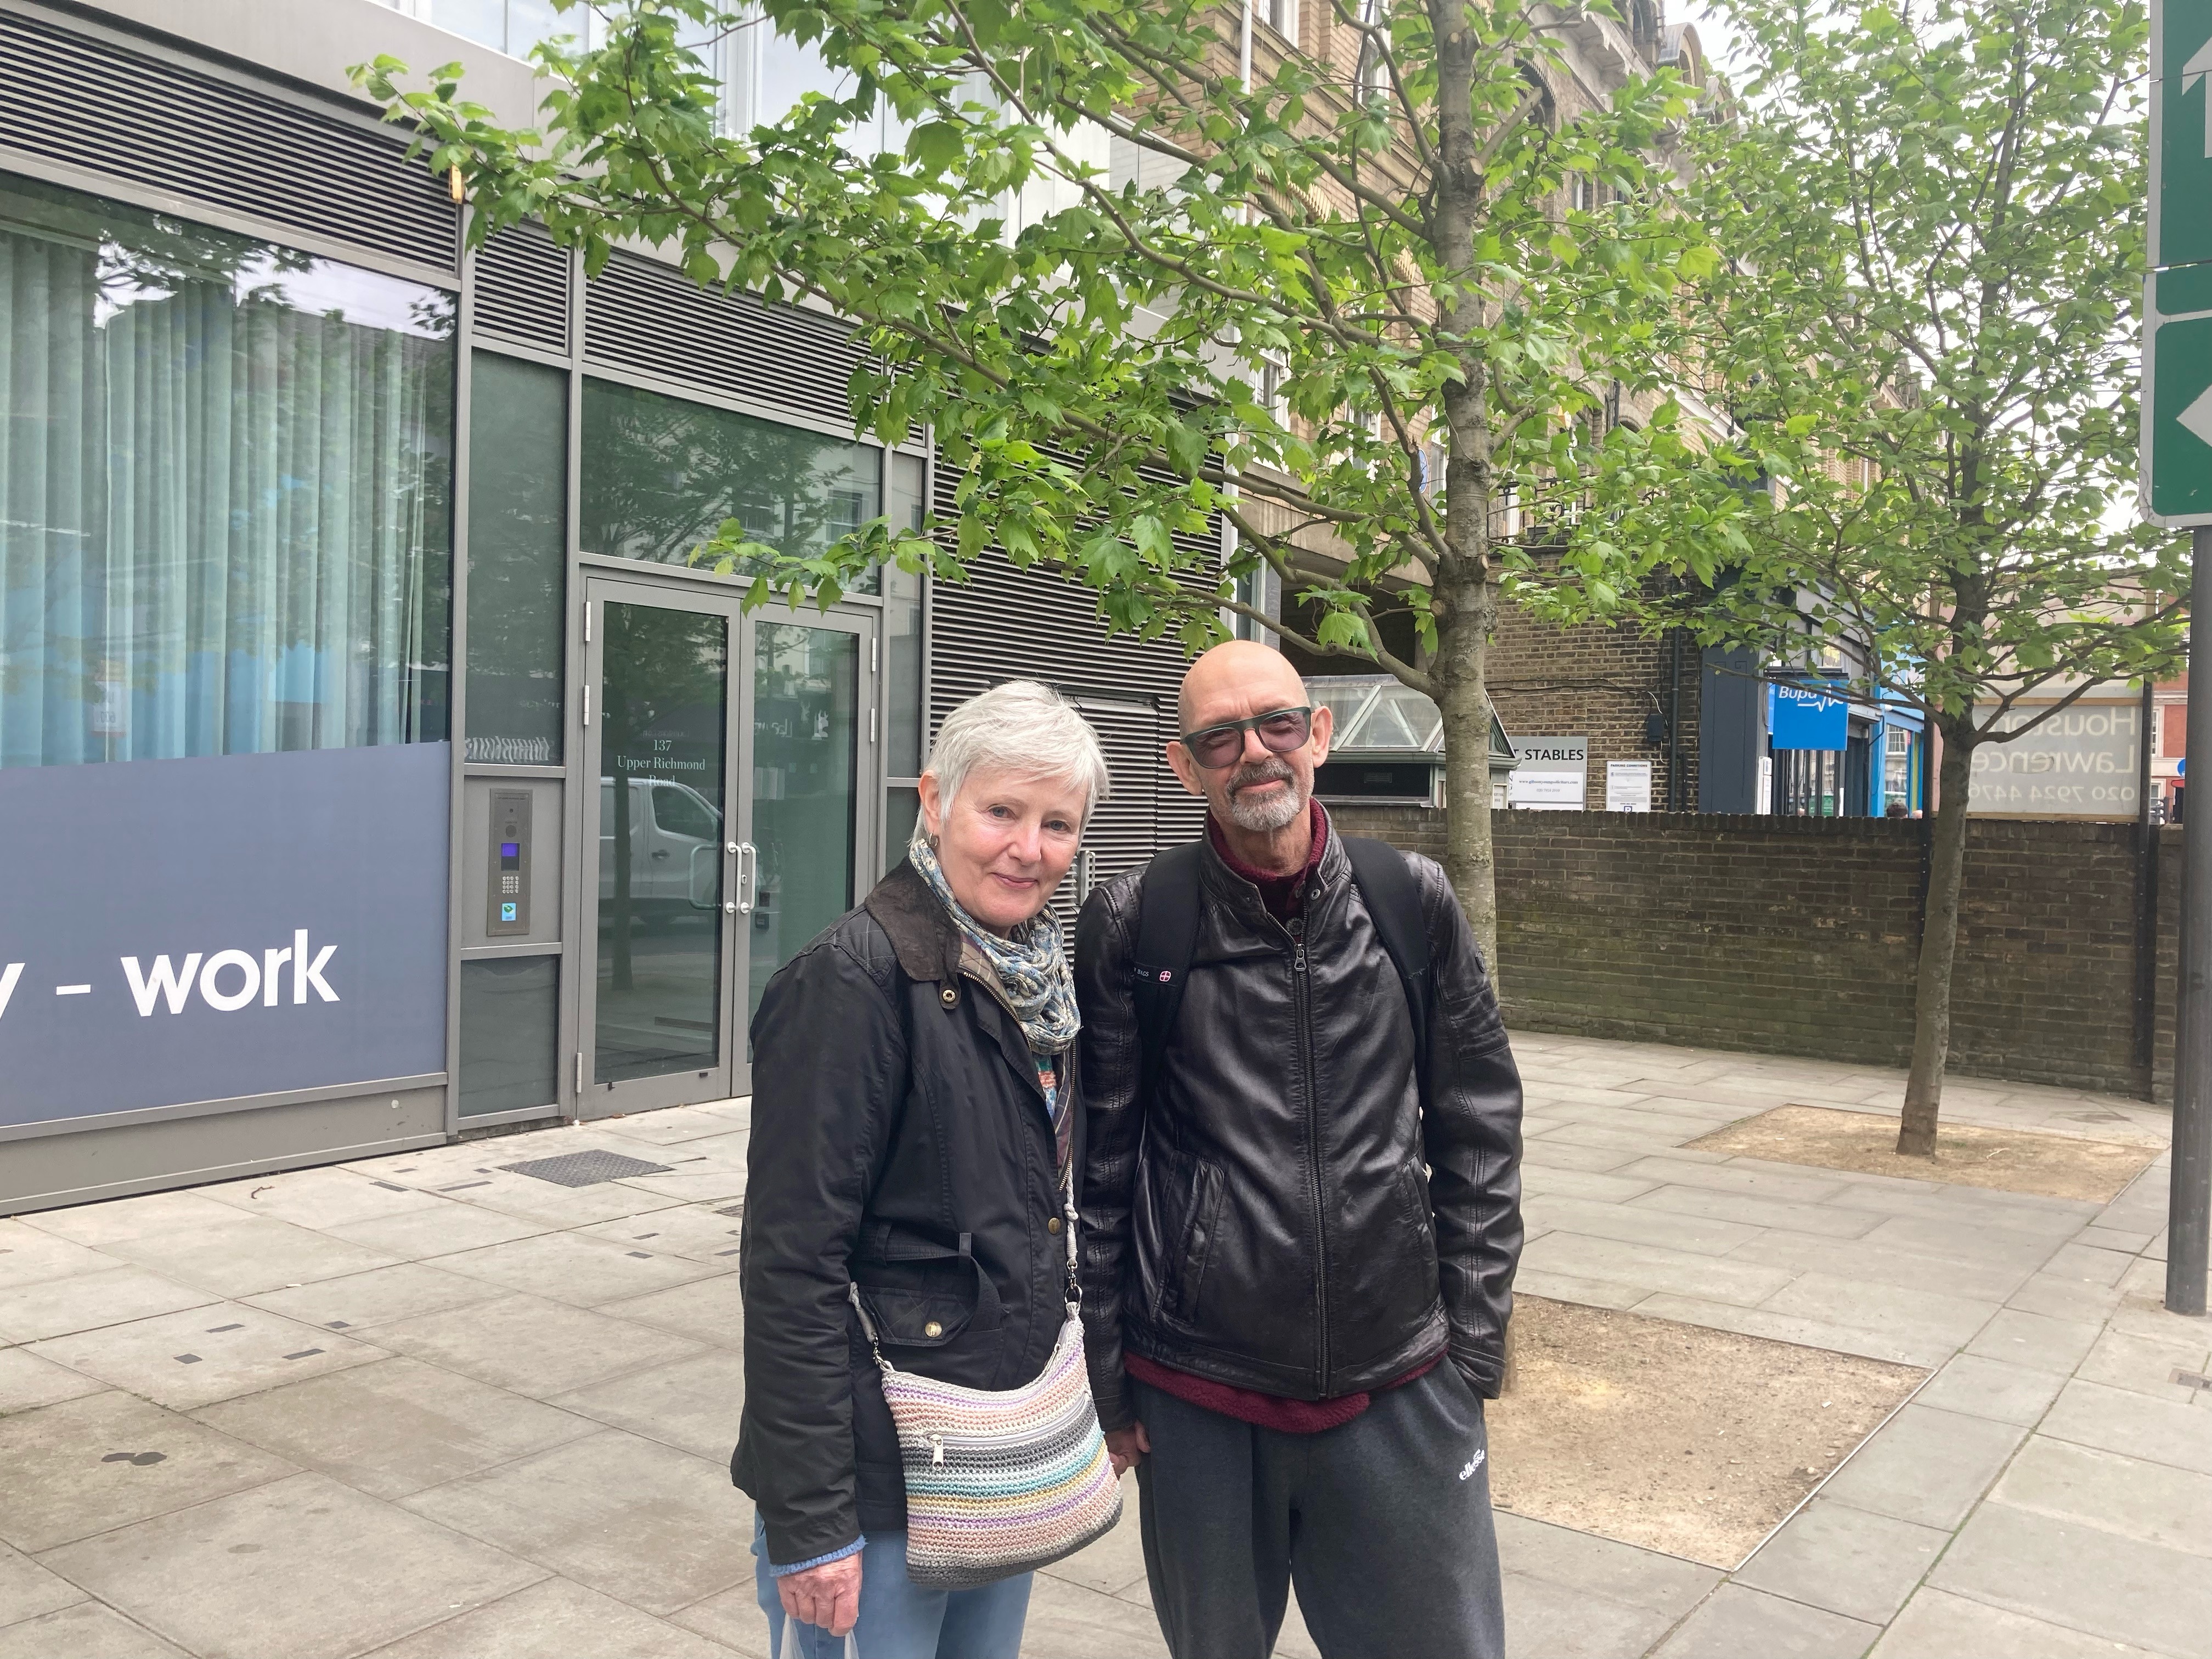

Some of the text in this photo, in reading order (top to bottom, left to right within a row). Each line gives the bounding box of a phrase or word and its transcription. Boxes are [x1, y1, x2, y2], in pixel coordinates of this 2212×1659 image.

[653, 739, 673, 752] 137
[1525, 749, 1584, 761] STABLES
[617, 755, 706, 771] Upper Richmond
[648, 774, 675, 787] Road
[120, 928, 341, 1017] work
